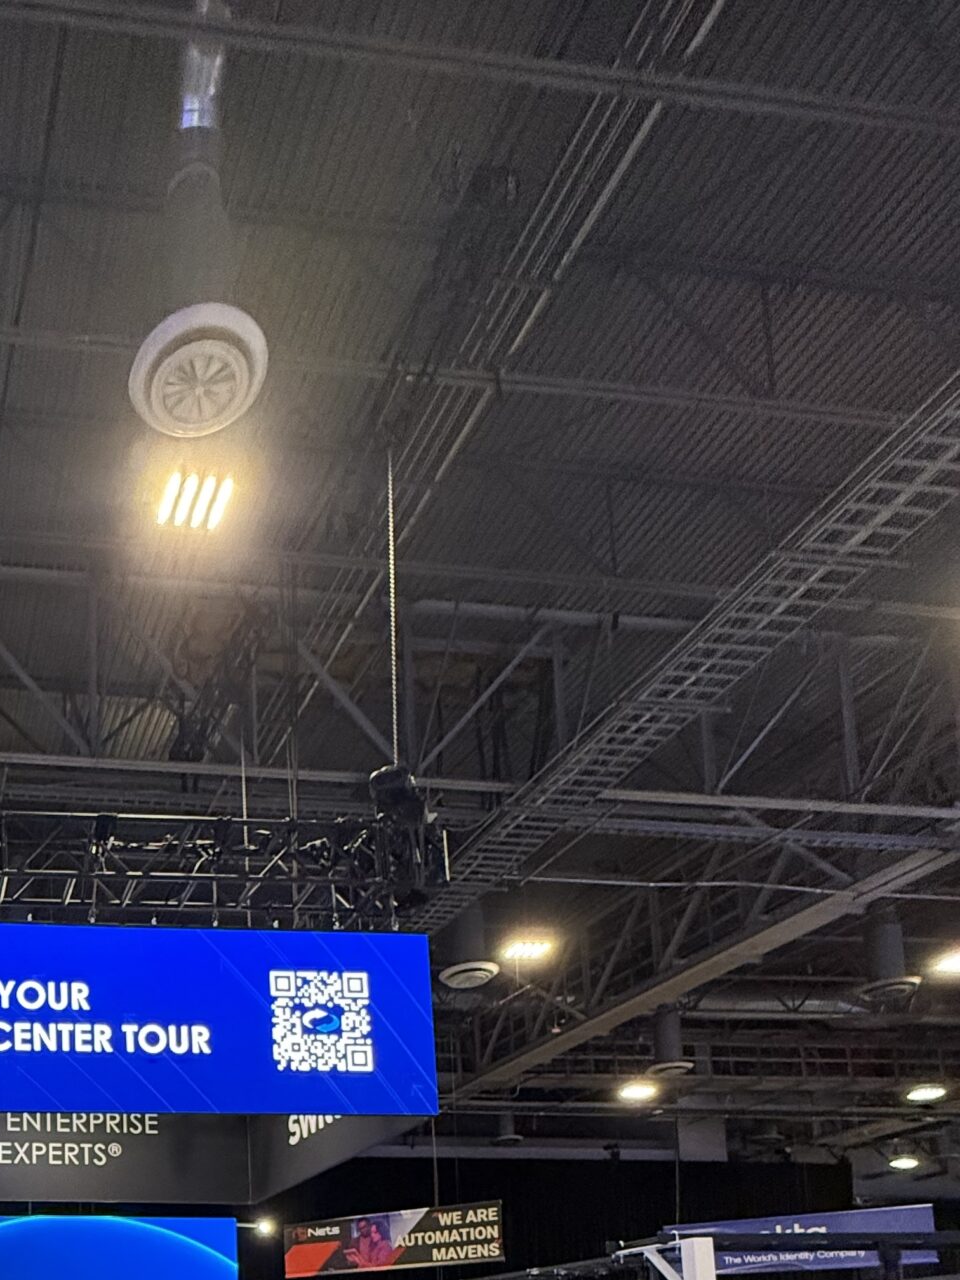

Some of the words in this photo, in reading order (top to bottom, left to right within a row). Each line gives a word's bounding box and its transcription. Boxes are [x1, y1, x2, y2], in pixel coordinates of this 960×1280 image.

[121, 1023, 212, 1055] TOUR
[6, 1112, 159, 1134] ENTERPRISE
[438, 1210, 463, 1226] WE
[465, 1207, 499, 1223] ARE
[395, 1225, 500, 1248] AUTOMATION
[431, 1242, 501, 1261] MAVENS
[724, 1255, 742, 1265] The
[780, 1251, 815, 1261] Identity
